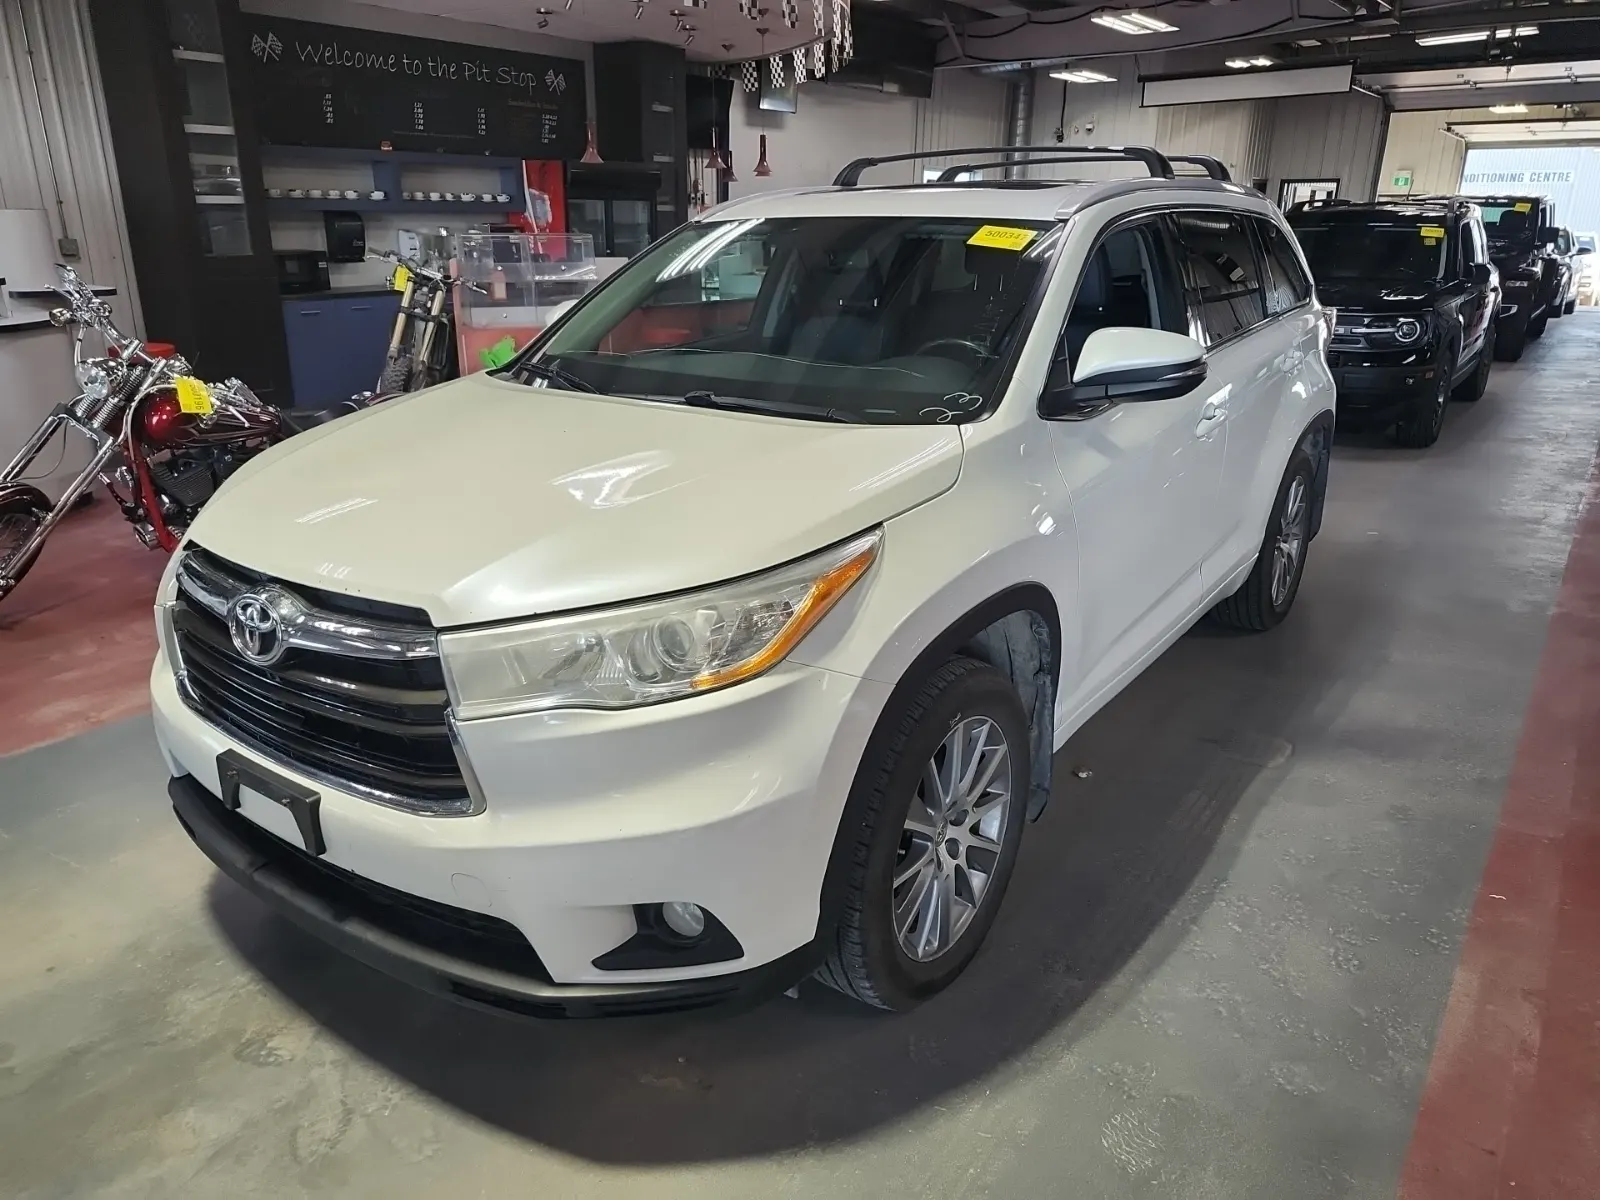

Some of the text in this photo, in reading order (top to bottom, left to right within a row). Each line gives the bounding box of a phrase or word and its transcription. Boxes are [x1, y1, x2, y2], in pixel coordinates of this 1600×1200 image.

[295, 41, 537, 96] Welcome to the Pit Stop
[1529, 171, 1572, 182] CENTRE
[984, 230, 1030, 241] 500347
